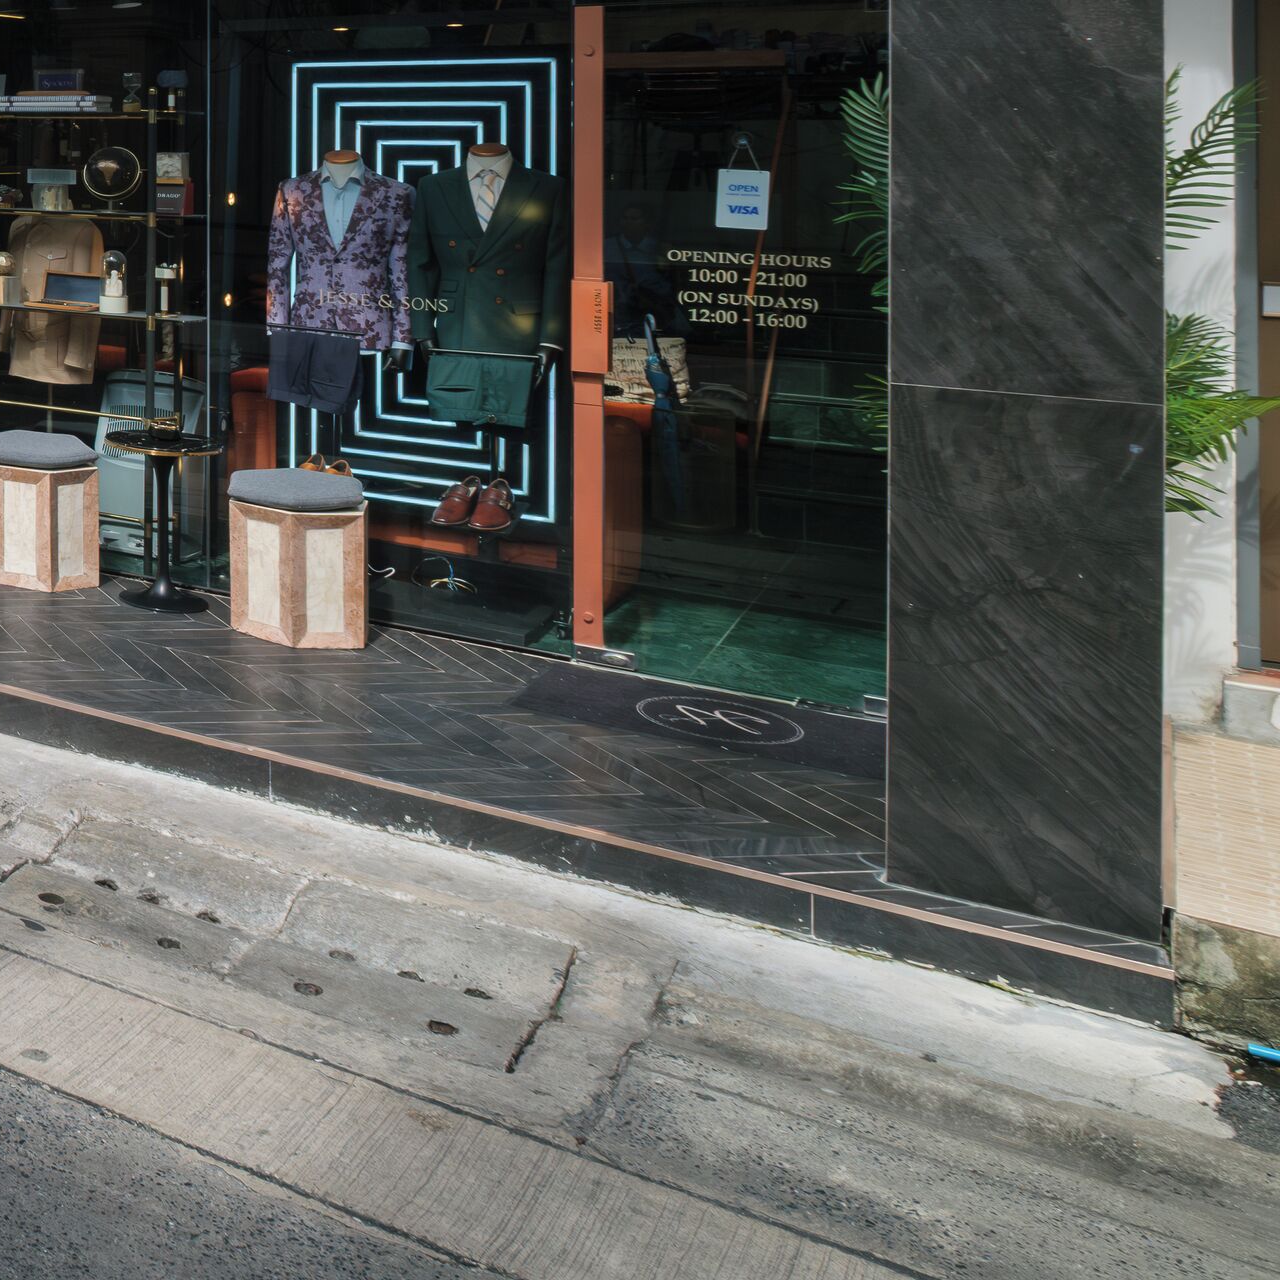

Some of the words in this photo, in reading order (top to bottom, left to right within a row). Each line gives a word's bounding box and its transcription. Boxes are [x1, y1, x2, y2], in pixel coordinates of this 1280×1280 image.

[728, 184, 759, 192] OPEN
[726, 204, 759, 215] VISA
[667, 249, 755, 265] OPENING
[760, 254, 832, 269] HOURS
[689, 269, 738, 284] 10:00
[756, 272, 807, 287] 21:00
[319, 288, 371, 307] JESSE
[378, 294, 394, 309] &
[401, 296, 449, 313] SONS
[678, 290, 713, 305] (ON
[717, 292, 819, 313] SUNDAYS)
[688, 308, 738, 324] 12:00
[756, 313, 807, 329] 16:00
